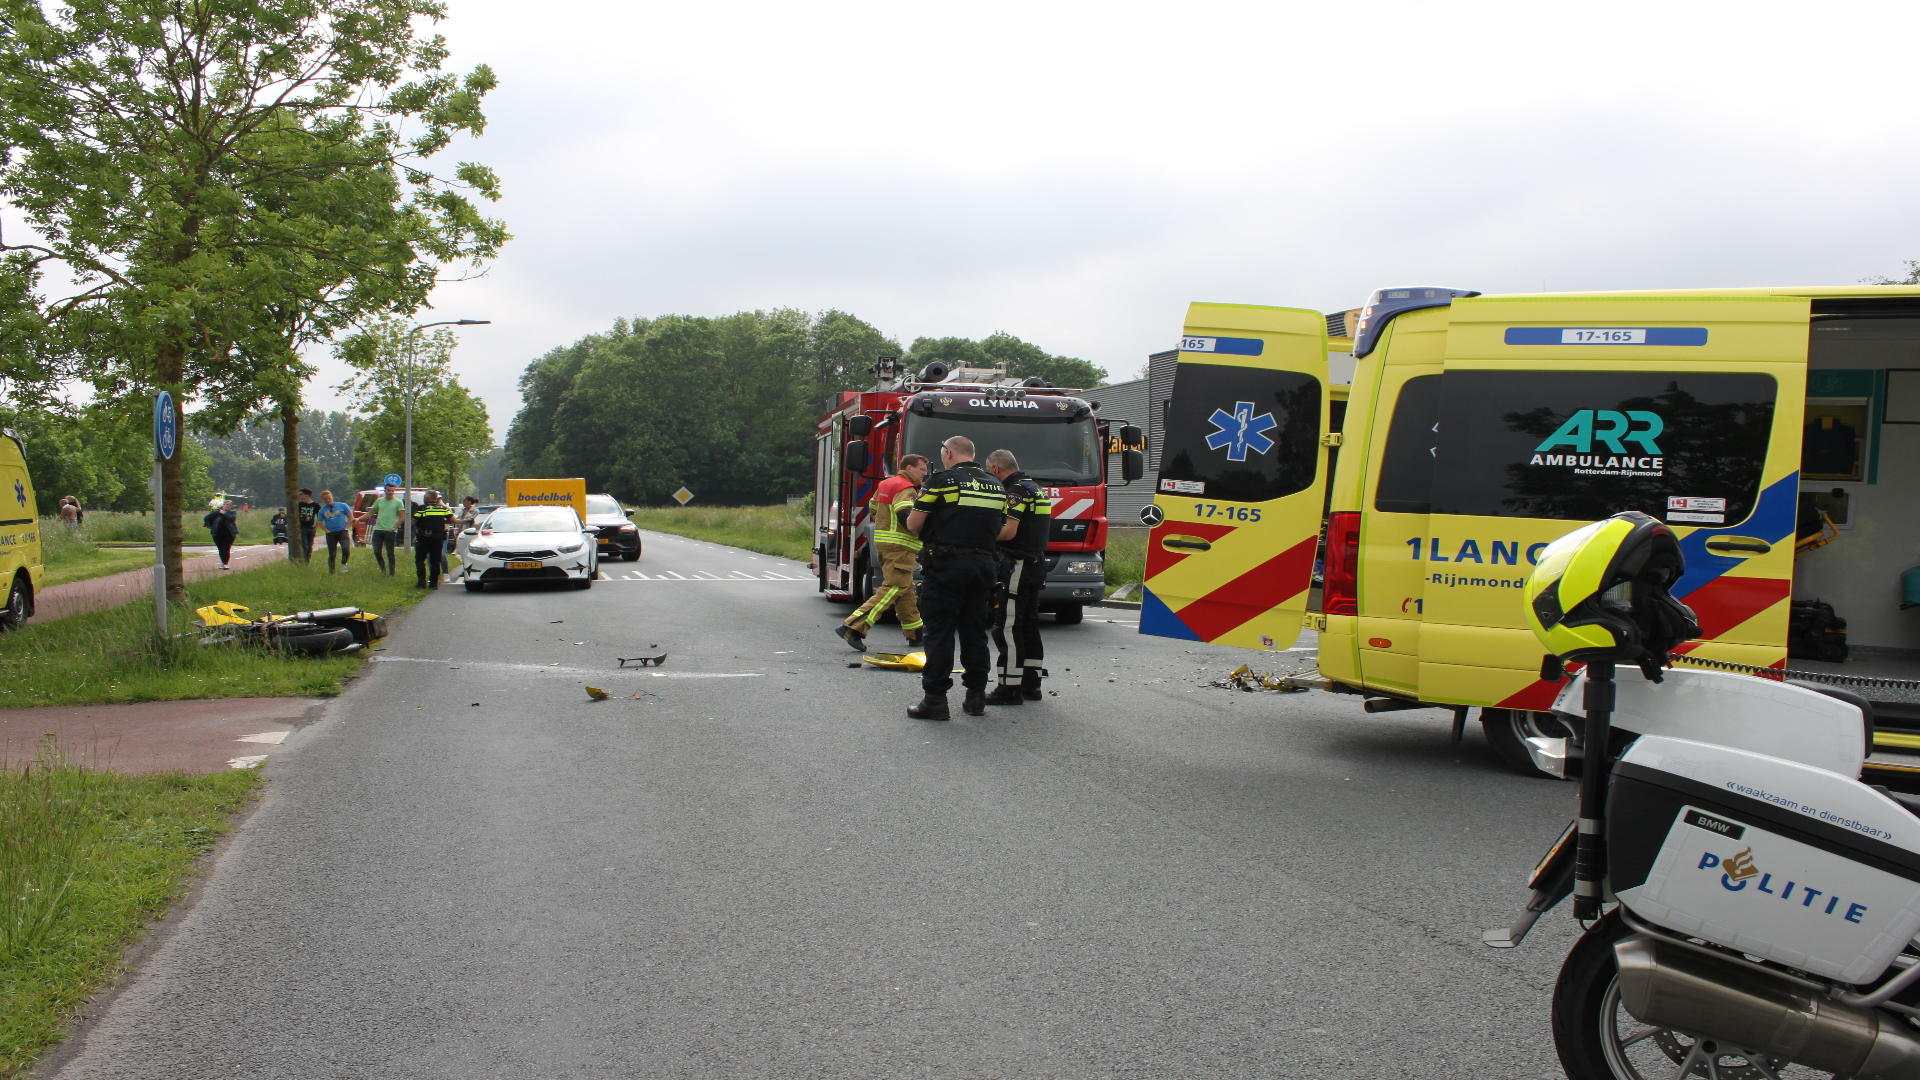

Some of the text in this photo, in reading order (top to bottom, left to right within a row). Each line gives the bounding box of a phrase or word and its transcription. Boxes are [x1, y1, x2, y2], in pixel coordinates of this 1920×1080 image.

[1575, 331, 1632, 341] 17-165
[968, 398, 1039, 409] OLYMPIA
[1534, 409, 1664, 455] ARR
[1530, 454, 1663, 469] AMBULANCE
[1574, 468, 1663, 477] Rotterdam-Rijnmond
[517, 492, 573, 501] boedelbak
[1194, 503, 1262, 522] 17-165
[1060, 524, 1086, 532] LF
[0, 534, 17, 547] ANCE
[1801, 804, 1817, 816] en
[1697, 816, 1731, 833] BMW
[1698, 851, 1867, 923] POLITIE
